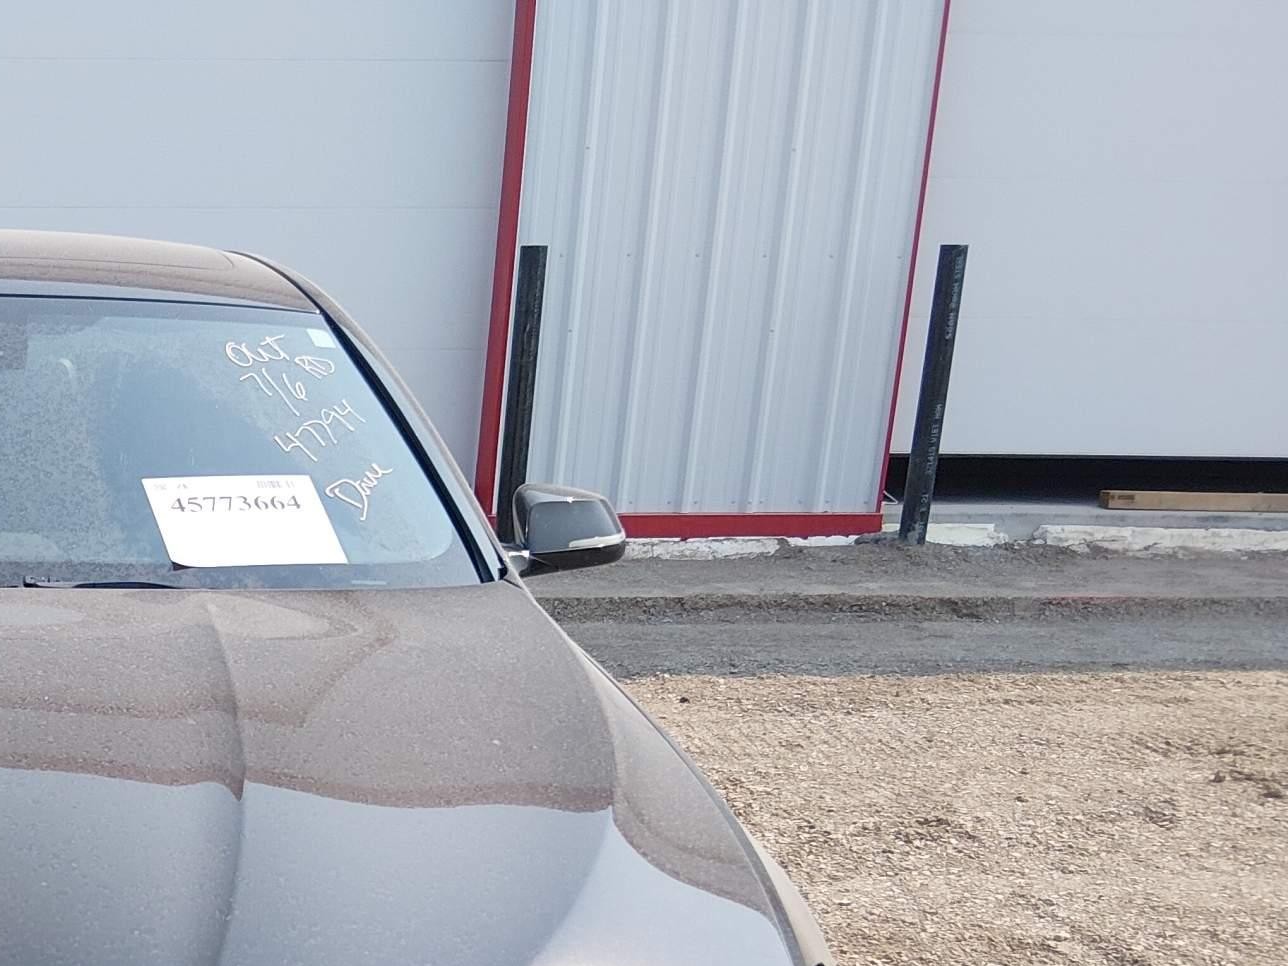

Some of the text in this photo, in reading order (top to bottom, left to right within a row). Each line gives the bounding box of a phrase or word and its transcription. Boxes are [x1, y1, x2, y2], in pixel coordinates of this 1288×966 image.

[240, 367, 309, 417] 7/6
[274, 399, 367, 462] 47794
[171, 495, 302, 513] 45773664
